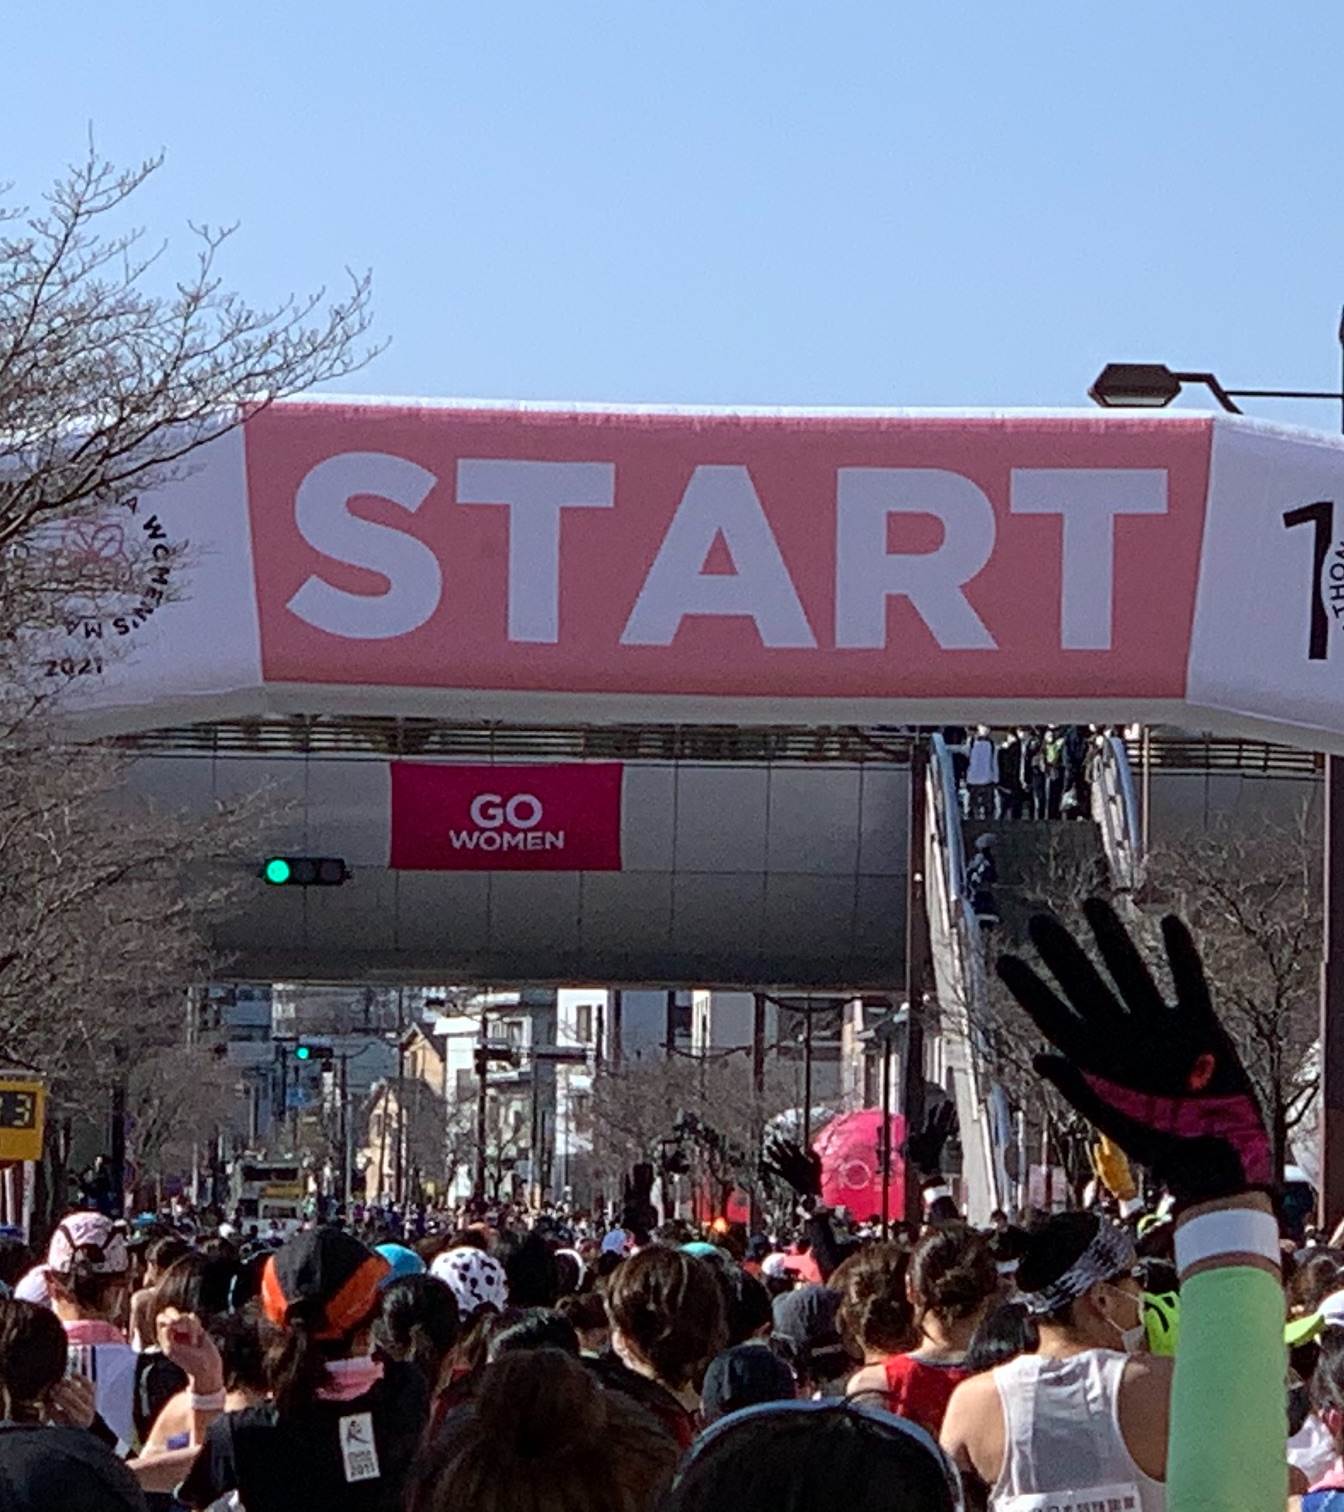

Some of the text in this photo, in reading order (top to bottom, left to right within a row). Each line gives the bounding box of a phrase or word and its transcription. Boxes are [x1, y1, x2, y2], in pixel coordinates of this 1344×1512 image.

[286, 451, 1168, 651] START
[470, 793, 543, 829] GO
[448, 829, 565, 851] WOMEN
